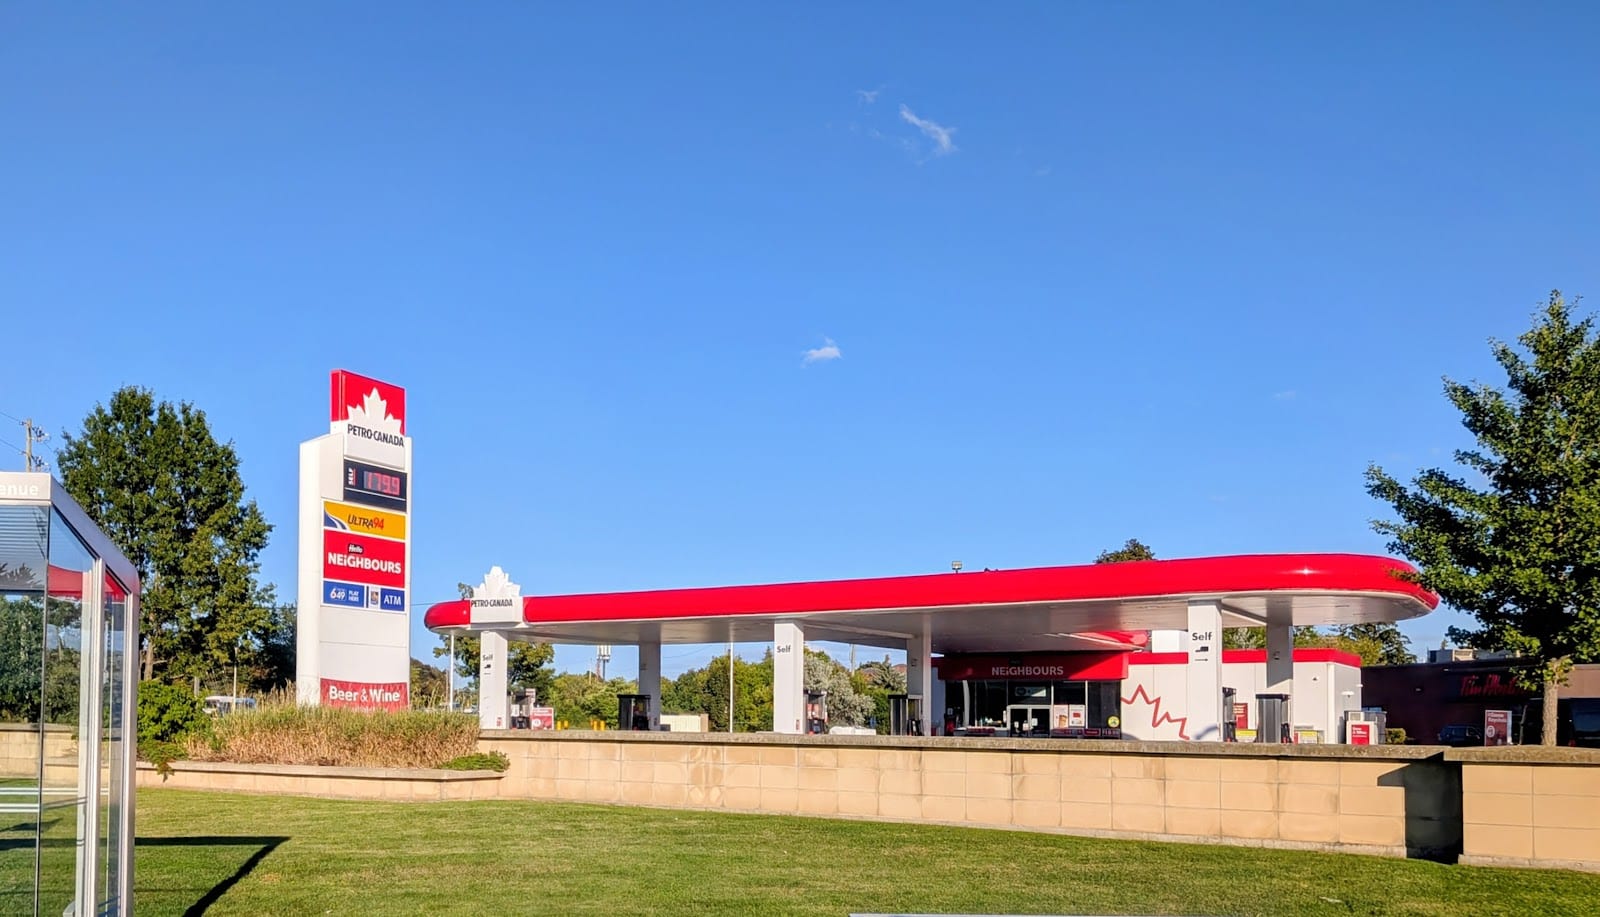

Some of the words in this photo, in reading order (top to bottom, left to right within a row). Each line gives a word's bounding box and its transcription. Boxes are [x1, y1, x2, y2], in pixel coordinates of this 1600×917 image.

[348, 544, 363, 554] Hello
[383, 594, 402, 606] ATM
[1191, 631, 1212, 641] Self
[777, 645, 791, 653] Self
[482, 654, 493, 662] Self
[329, 685, 359, 702] Beer
[360, 688, 368, 702] &
[369, 688, 401, 702] Wine
